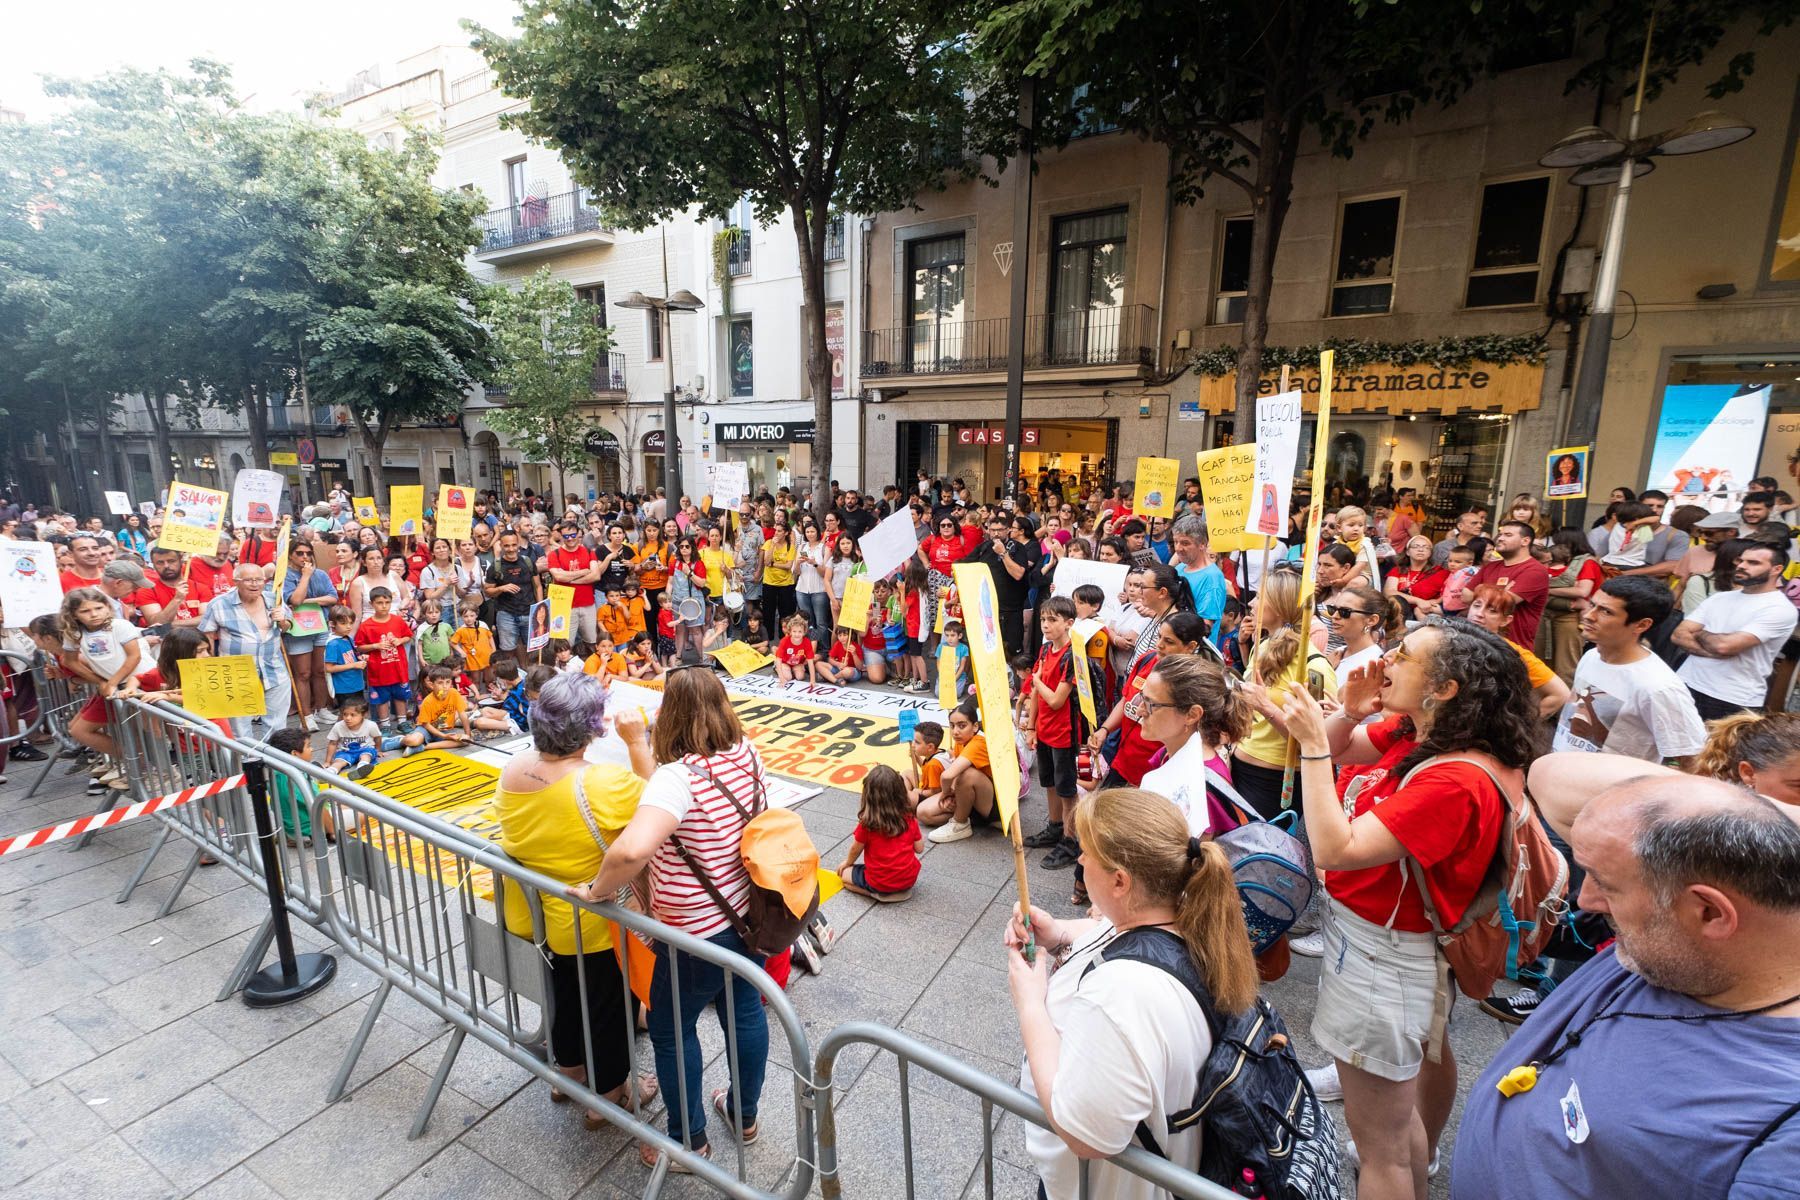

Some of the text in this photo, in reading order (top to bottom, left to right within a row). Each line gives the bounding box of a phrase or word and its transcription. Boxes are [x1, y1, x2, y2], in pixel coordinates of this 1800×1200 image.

[723, 425, 785, 440] MI JOYERO
[961, 431, 1035, 442] CASS
[1201, 457, 1226, 472] CAP
[1209, 473, 1255, 486] TANCADA
[1208, 494, 1244, 504] MENTRE
[798, 684, 837, 696] NO
[837, 689, 871, 702] ES
[878, 695, 944, 712] TANC
